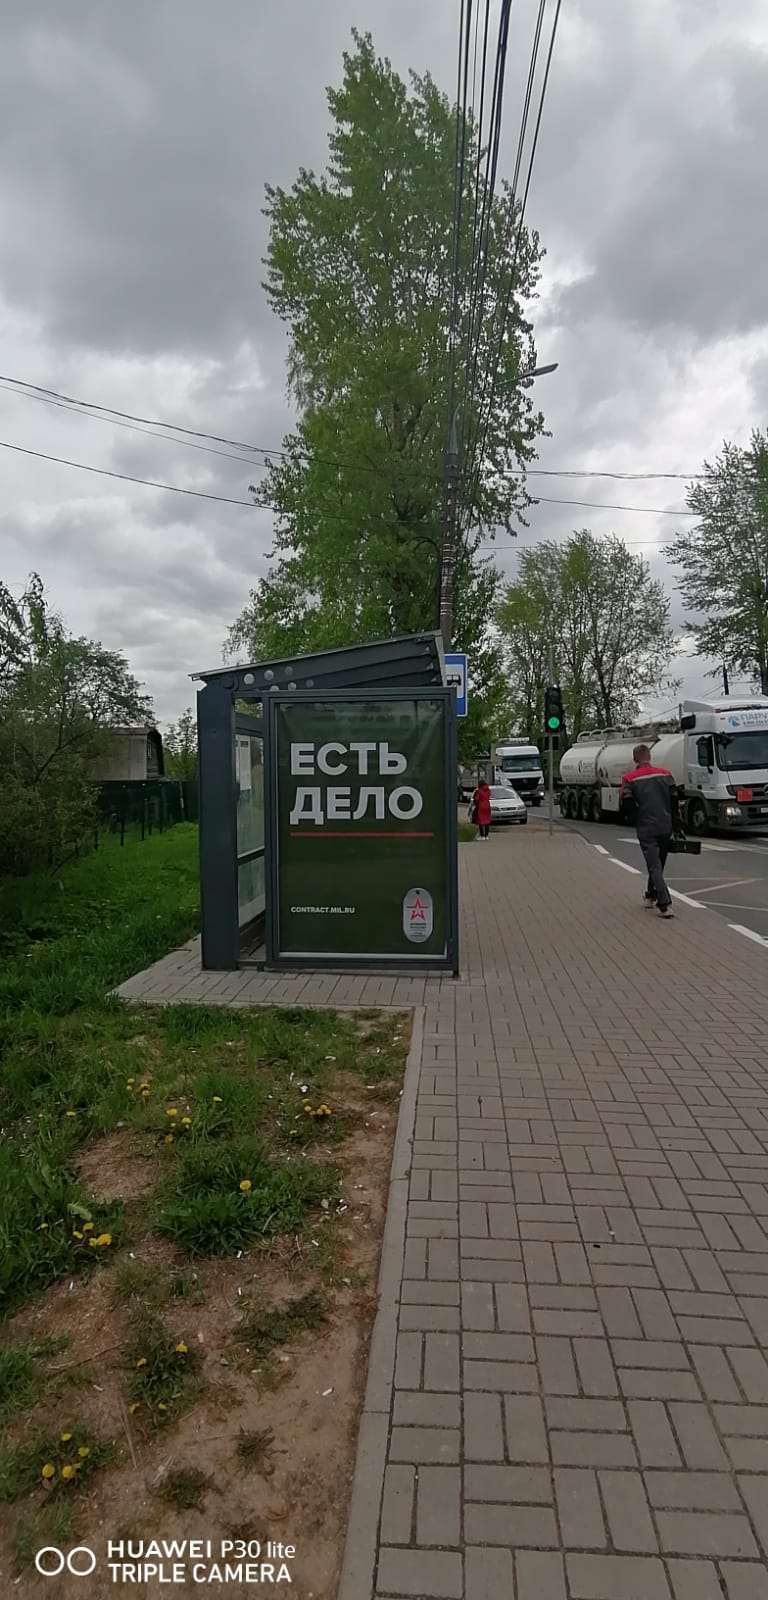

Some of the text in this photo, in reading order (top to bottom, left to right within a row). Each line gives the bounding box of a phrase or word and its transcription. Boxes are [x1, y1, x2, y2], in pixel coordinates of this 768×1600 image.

[290, 742, 408, 776] ЕСТЬ
[289, 785, 423, 825] ДЕЛО
[290, 906, 356, 914] CONTRACT.MIL.RU
